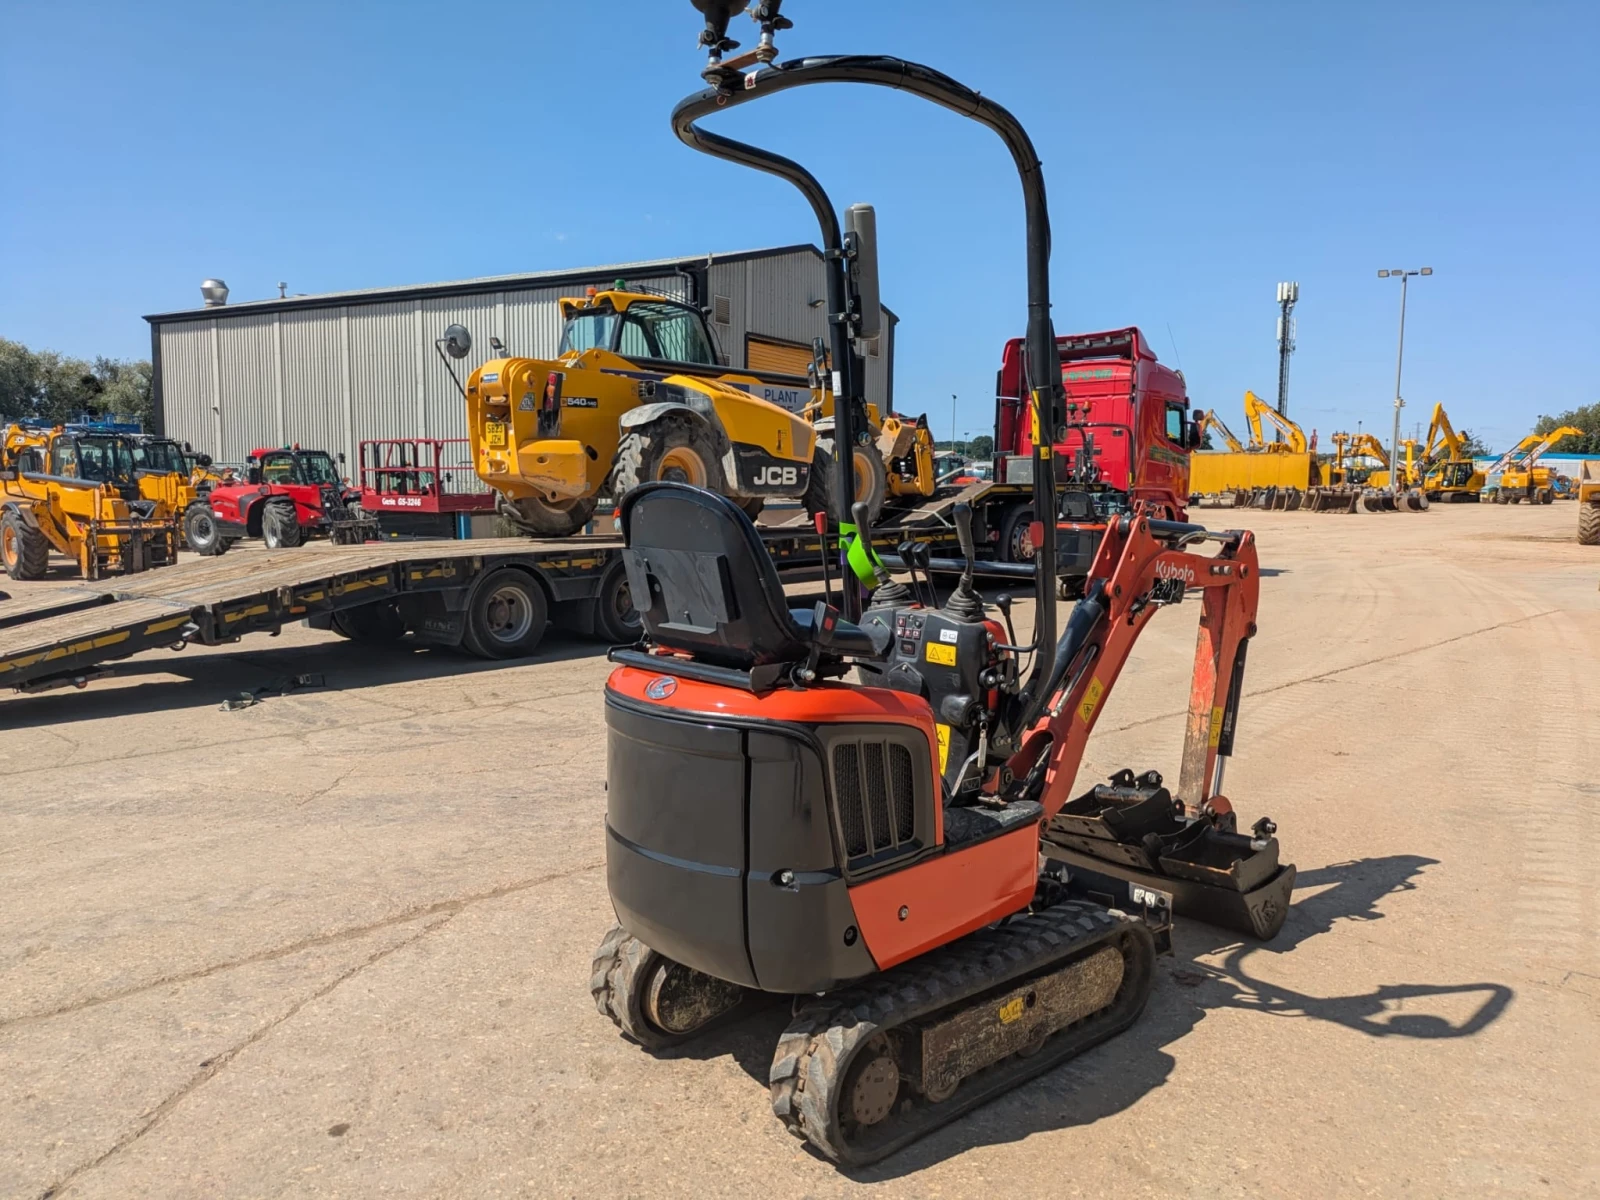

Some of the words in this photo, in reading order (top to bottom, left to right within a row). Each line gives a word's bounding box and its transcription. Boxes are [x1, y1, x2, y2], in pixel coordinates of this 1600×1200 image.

[764, 388, 798, 403] PLANT
[753, 466, 797, 485] JCB
[1155, 560, 1194, 581] Kubota
